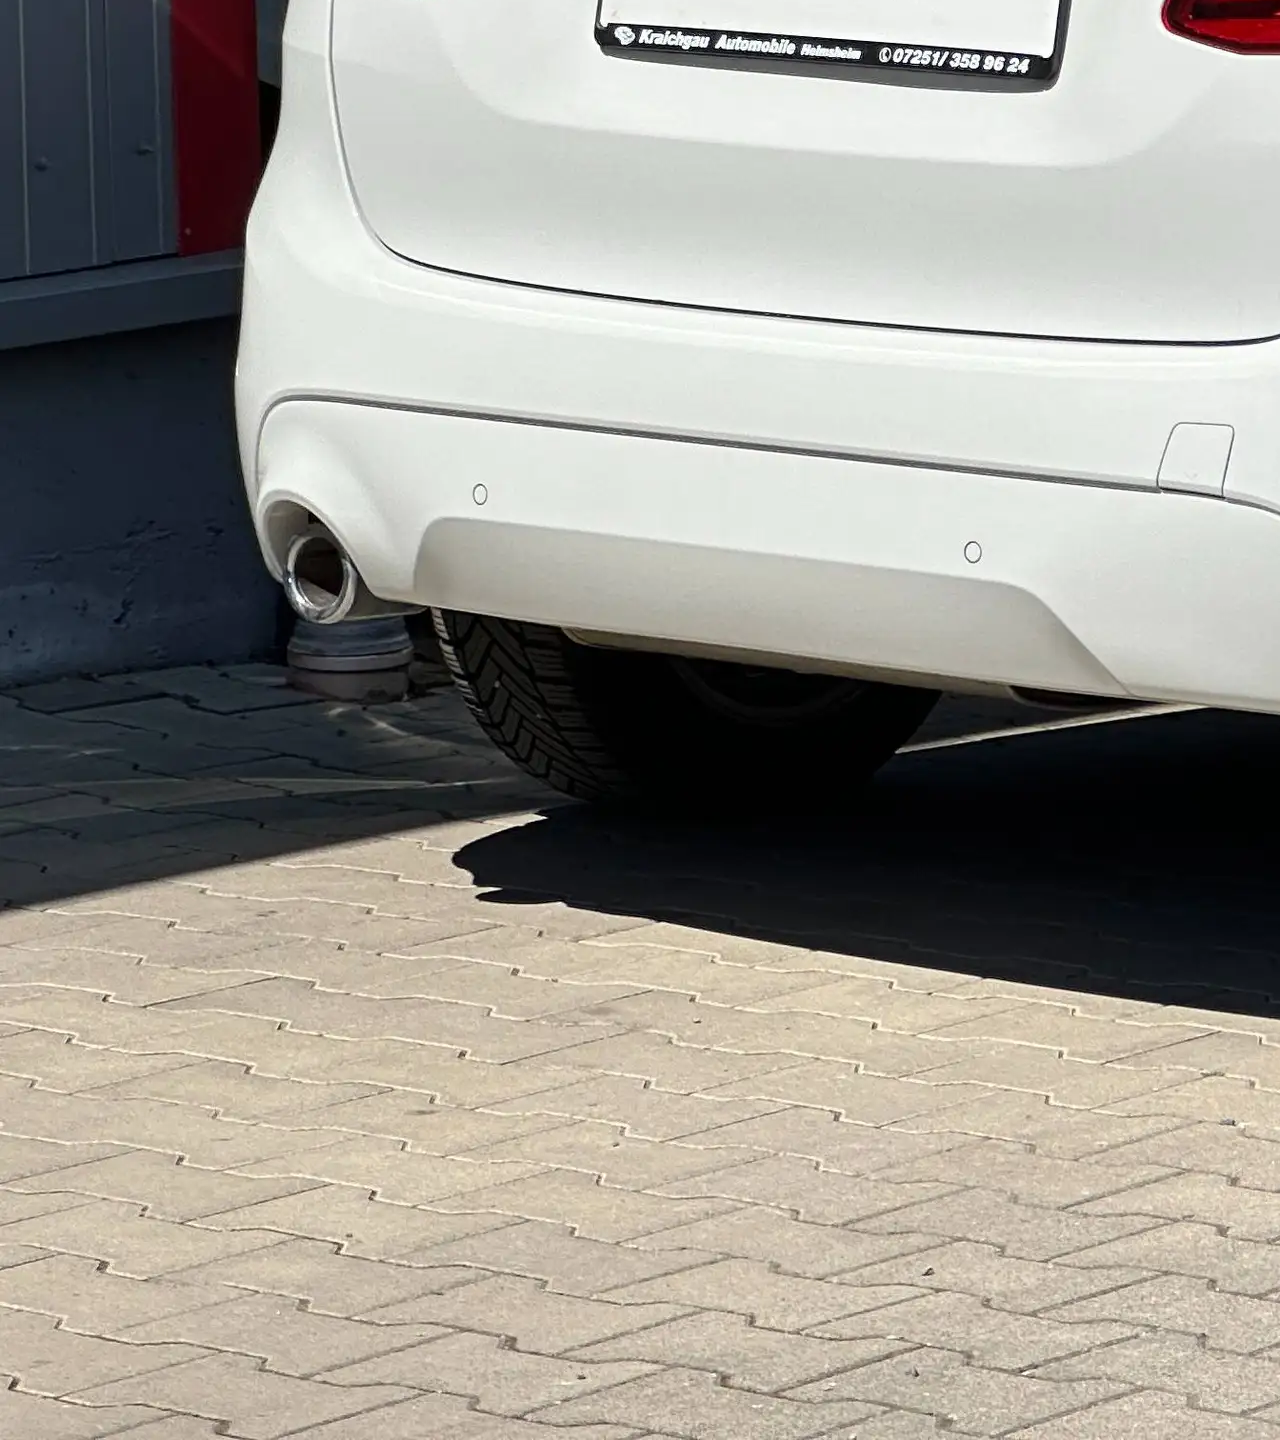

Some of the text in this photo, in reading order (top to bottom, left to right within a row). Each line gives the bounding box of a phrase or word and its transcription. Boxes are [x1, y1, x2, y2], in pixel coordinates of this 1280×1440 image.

[638, 28, 710, 51] Kraichgau
[714, 33, 797, 56] Automobile
[893, 47, 949, 68] 07251/
[950, 52, 982, 70] 358
[983, 55, 1005, 72] 96
[1006, 57, 1031, 74] 24
